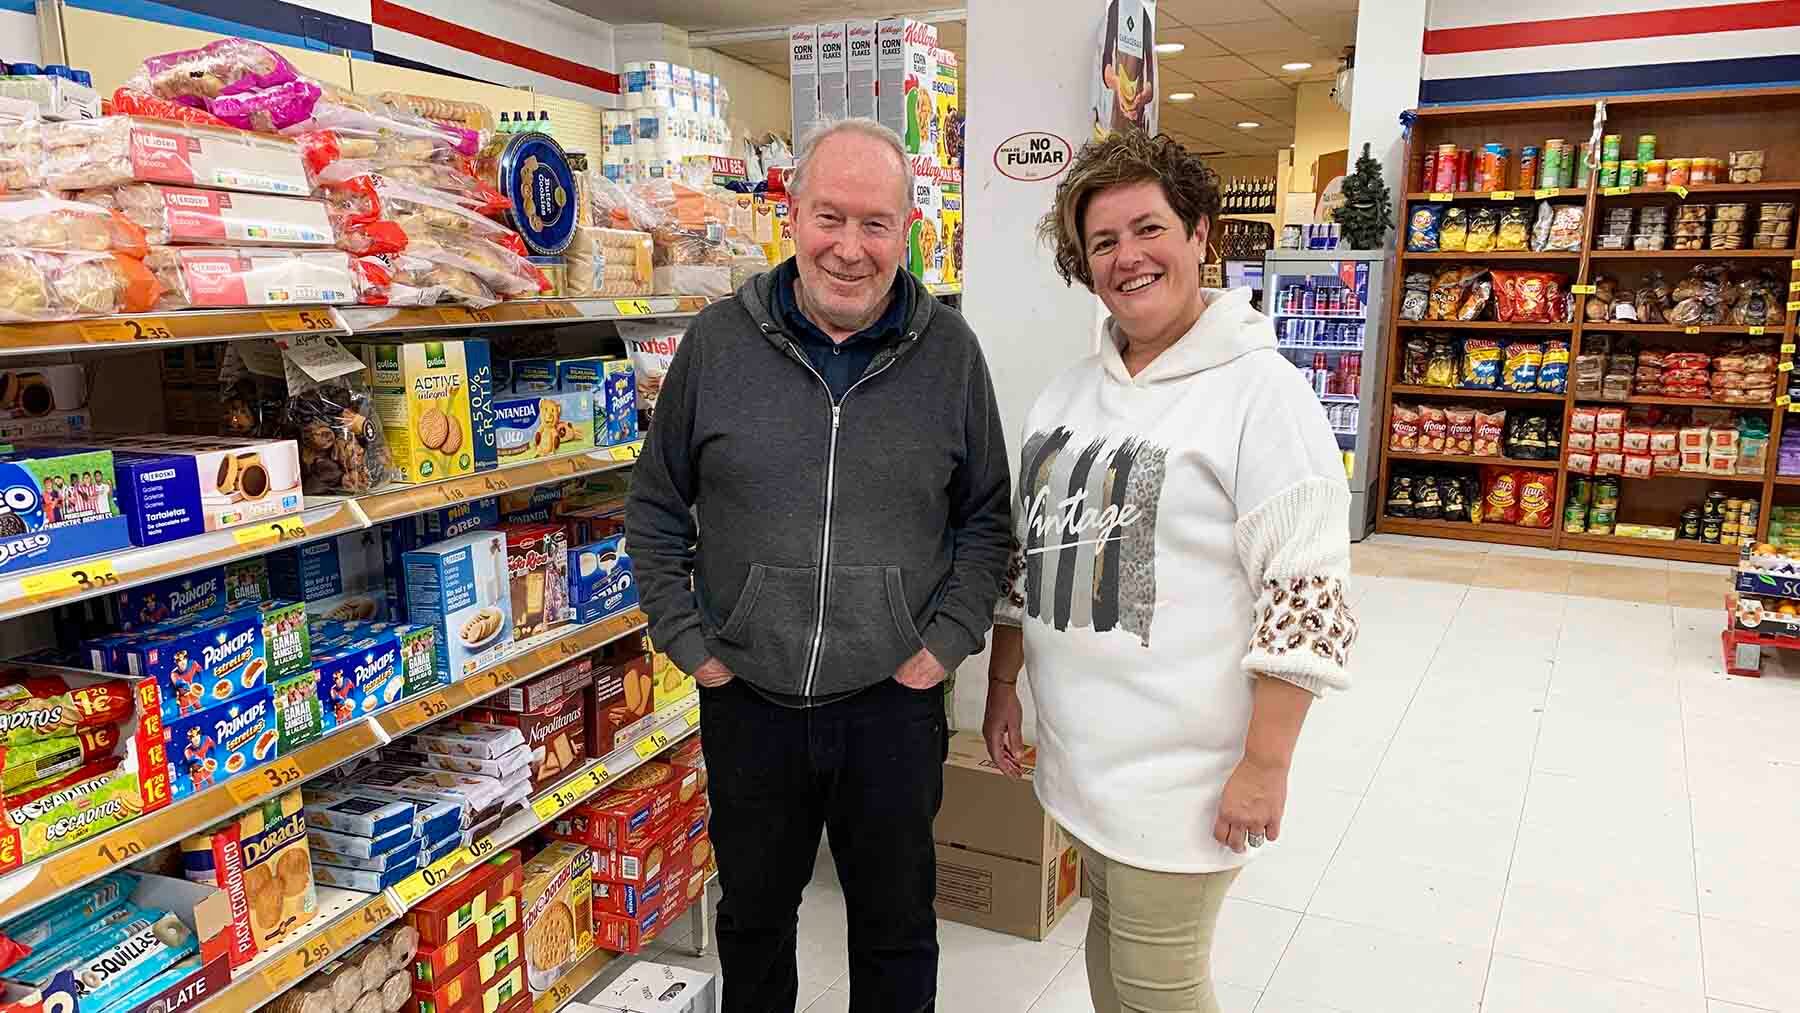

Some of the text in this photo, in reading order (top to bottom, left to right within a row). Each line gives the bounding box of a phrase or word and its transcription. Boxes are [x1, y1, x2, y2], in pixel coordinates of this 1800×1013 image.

[794, 45, 813, 54] CORN
[822, 43, 842, 53] CORN
[851, 40, 871, 50] CORN
[851, 48, 871, 57] FLAKES
[881, 39, 901, 48] CORN
[882, 47, 901, 55] FLAKES
[794, 53, 813, 61] FLAKES
[822, 51, 842, 60] FLAKES
[913, 52, 926, 65] CORN
[1030, 137, 1050, 151] NO
[1007, 150, 1064, 166] FUMAR
[537, 174, 547, 217] Cookies
[544, 177, 553, 215] Butter
[916, 184, 931, 196] CORN
[631, 336, 677, 356] nutell
[427, 357, 446, 368] gullón
[414, 374, 461, 391] ACTIVE
[418, 389, 449, 400] integral
[479, 365, 495, 447] GRATIS
[145, 508, 186, 522] Tartaletas
[1024, 486, 1142, 556] Vintage
[446, 516, 481, 538] OREO
[526, 549, 549, 571] Rica
[169, 577, 217, 612] PRINCIPE
[202, 626, 255, 671] PRINCIPE
[272, 631, 301, 651] GANAR
[273, 643, 303, 660] CAMISETAS
[213, 646, 254, 677] Estrellas
[354, 648, 396, 687] PRINCIPE
[408, 652, 430, 670] GANAR
[284, 700, 311, 721] GANAR
[214, 699, 267, 745] PRINCIPE
[284, 713, 313, 730] CAMISETAS
[528, 706, 582, 748] Napolitanas
[226, 718, 266, 751] Estrellas
[46, 799, 121, 841] BOCADITOS
[218, 840, 252, 953] PACK ECONÓMICO
[572, 880, 592, 898] PRECIO
